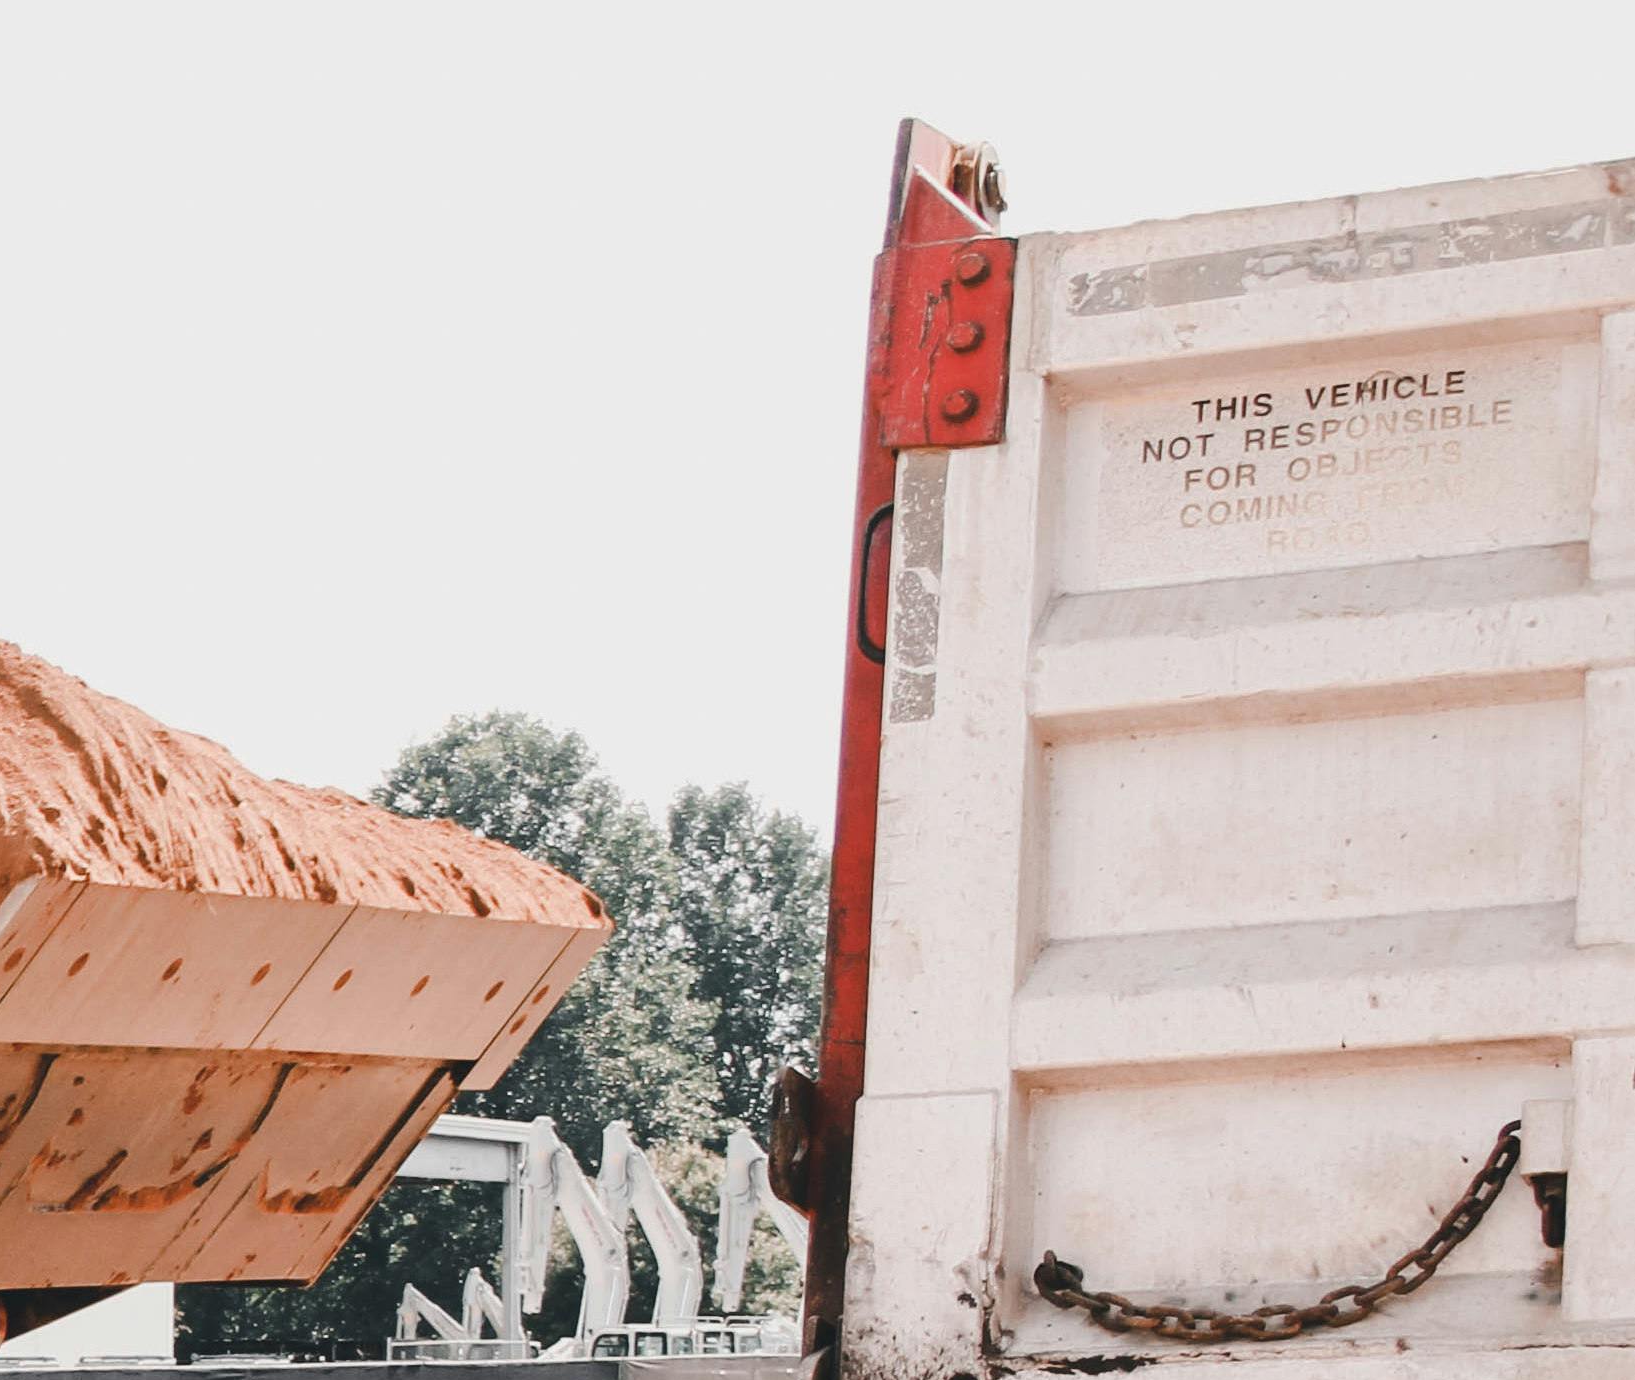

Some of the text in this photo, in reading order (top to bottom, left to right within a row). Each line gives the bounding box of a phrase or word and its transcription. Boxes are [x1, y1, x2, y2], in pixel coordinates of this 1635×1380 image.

[1192, 371, 1466, 423] THIS VEHICLE
[1141, 400, 1514, 463] NOT RESPONSIBLE
[1184, 464, 1256, 492] FOR
